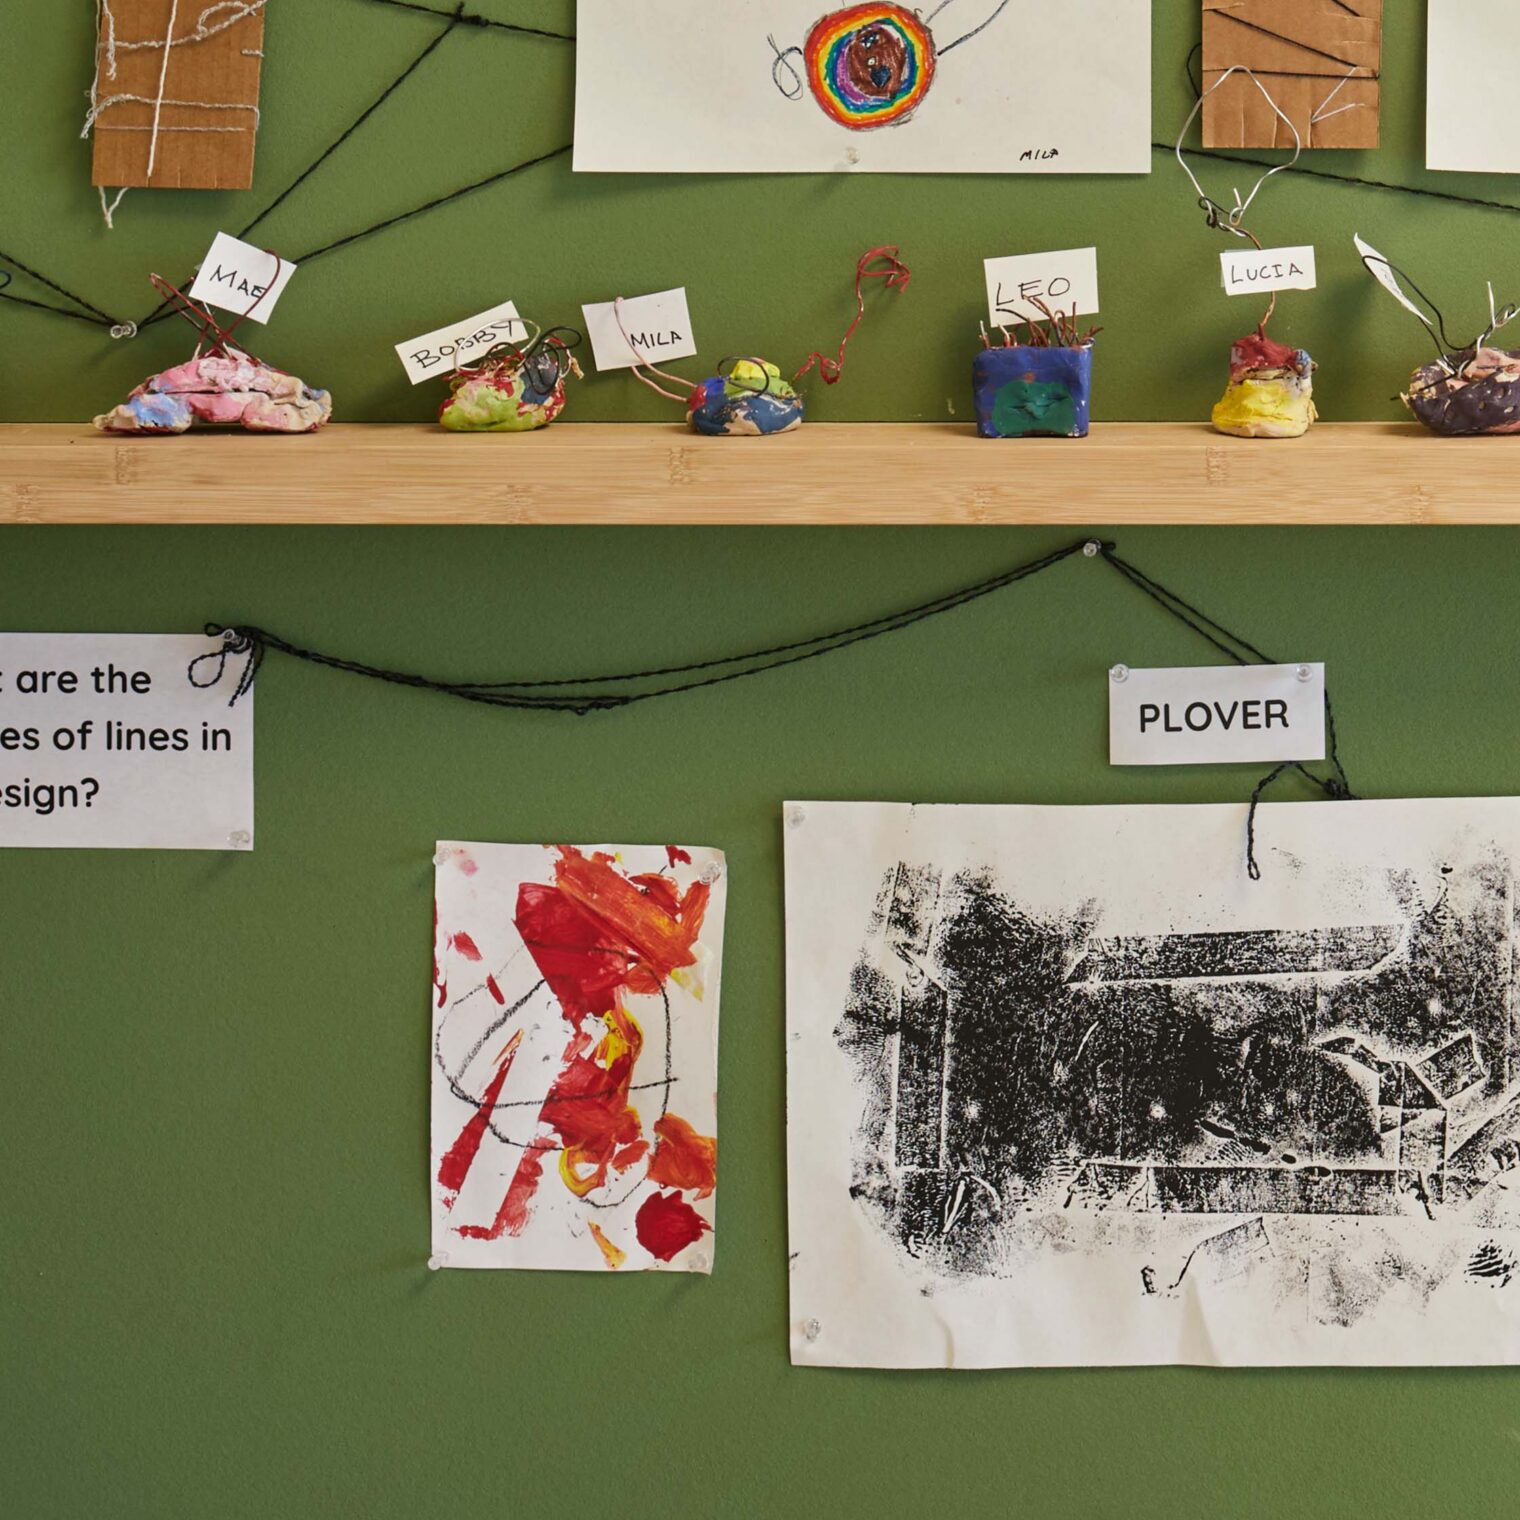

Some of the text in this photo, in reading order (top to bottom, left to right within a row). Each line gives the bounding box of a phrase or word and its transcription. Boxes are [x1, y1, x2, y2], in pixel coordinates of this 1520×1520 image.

[1019, 148, 1059, 161] MILA
[208, 264, 268, 300] MAE
[1231, 262, 1304, 284] LUCIA
[995, 277, 1071, 306] LEO
[409, 319, 513, 369] BOBBY
[630, 330, 683, 349] MILA
[16, 670, 79, 694] are
[90, 663, 152, 694] the
[1140, 699, 1289, 734] PLOVER
[52, 720, 94, 751] of
[106, 720, 189, 751] lines
[201, 721, 231, 751] in
[0, 777, 100, 815] sign?
